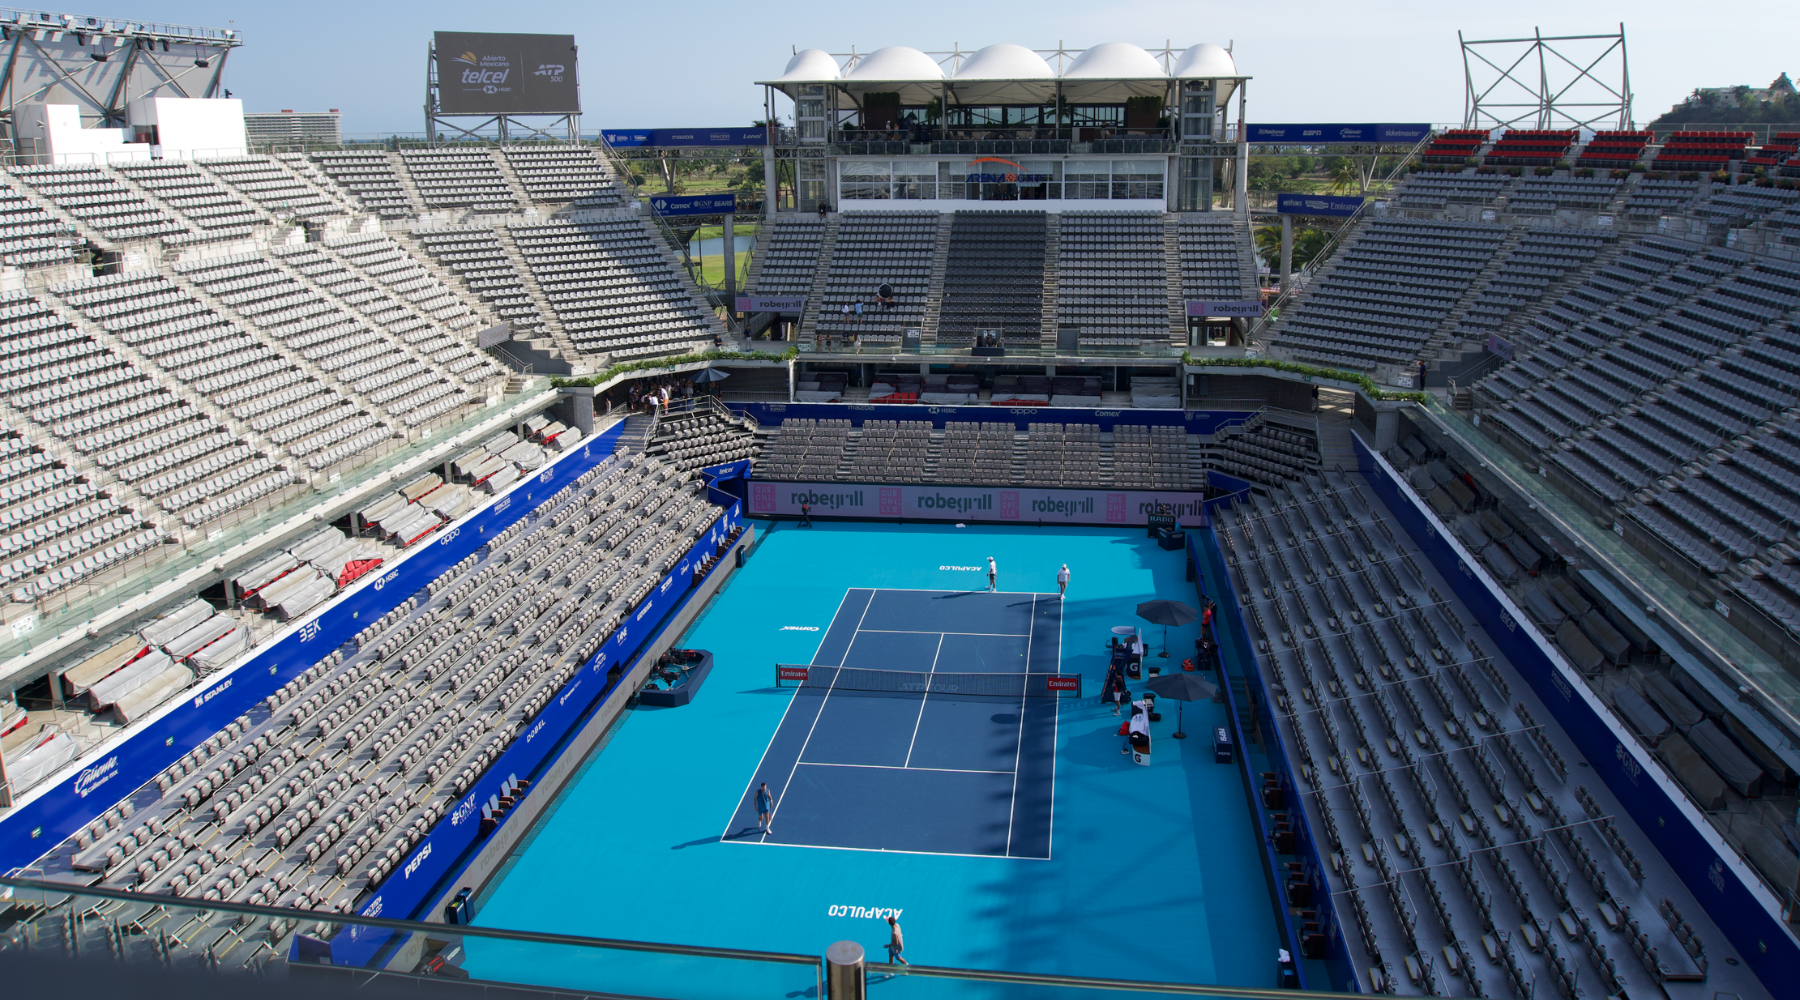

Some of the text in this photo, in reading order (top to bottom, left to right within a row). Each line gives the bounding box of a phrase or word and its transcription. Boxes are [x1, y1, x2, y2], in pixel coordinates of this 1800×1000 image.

[532, 64, 565, 76] ATP
[461, 68, 510, 84] telcel
[550, 75, 563, 83] 500
[1385, 129, 1420, 137] ticketmaster
[965, 173, 1043, 183] ARENA GNP
[670, 201, 692, 210] Comex
[1330, 202, 1358, 211] Emirates
[759, 300, 802, 311] robegrill
[1213, 304, 1259, 314] robegrill
[1010, 407, 1037, 416] oppo
[1094, 409, 1122, 417] Comex
[718, 465, 734, 476] telcel
[755, 486, 771, 494] QUE
[881, 489, 898, 497] QUE
[791, 489, 864, 509] robegrill
[917, 493, 992, 513] robegrill
[1108, 495, 1122, 503] QUE
[755, 502, 771, 510] LLE
[1032, 497, 1094, 517] robegrill
[1002, 509, 1016, 517] LLE
[1108, 512, 1122, 520] LLE
[1150, 515, 1174, 523] RADO
[440, 528, 461, 546] oppo
[385, 568, 399, 584] HSBC
[1500, 608, 1517, 633] telcel
[1129, 662, 1139, 672] G
[780, 670, 807, 678] Emirates
[900, 682, 959, 693] ATP TOUR
[1048, 680, 1076, 688] Emirates
[1551, 669, 1572, 698] PRINCESS
[204, 678, 233, 702] STANLEY
[526, 719, 546, 743] DOBEL
[1134, 754, 1142, 763] G
[1622, 751, 1641, 778] GNP
[458, 792, 476, 819] GNP
[404, 841, 432, 880] PEPSI
[828, 904, 904, 920] ACAPULCO
